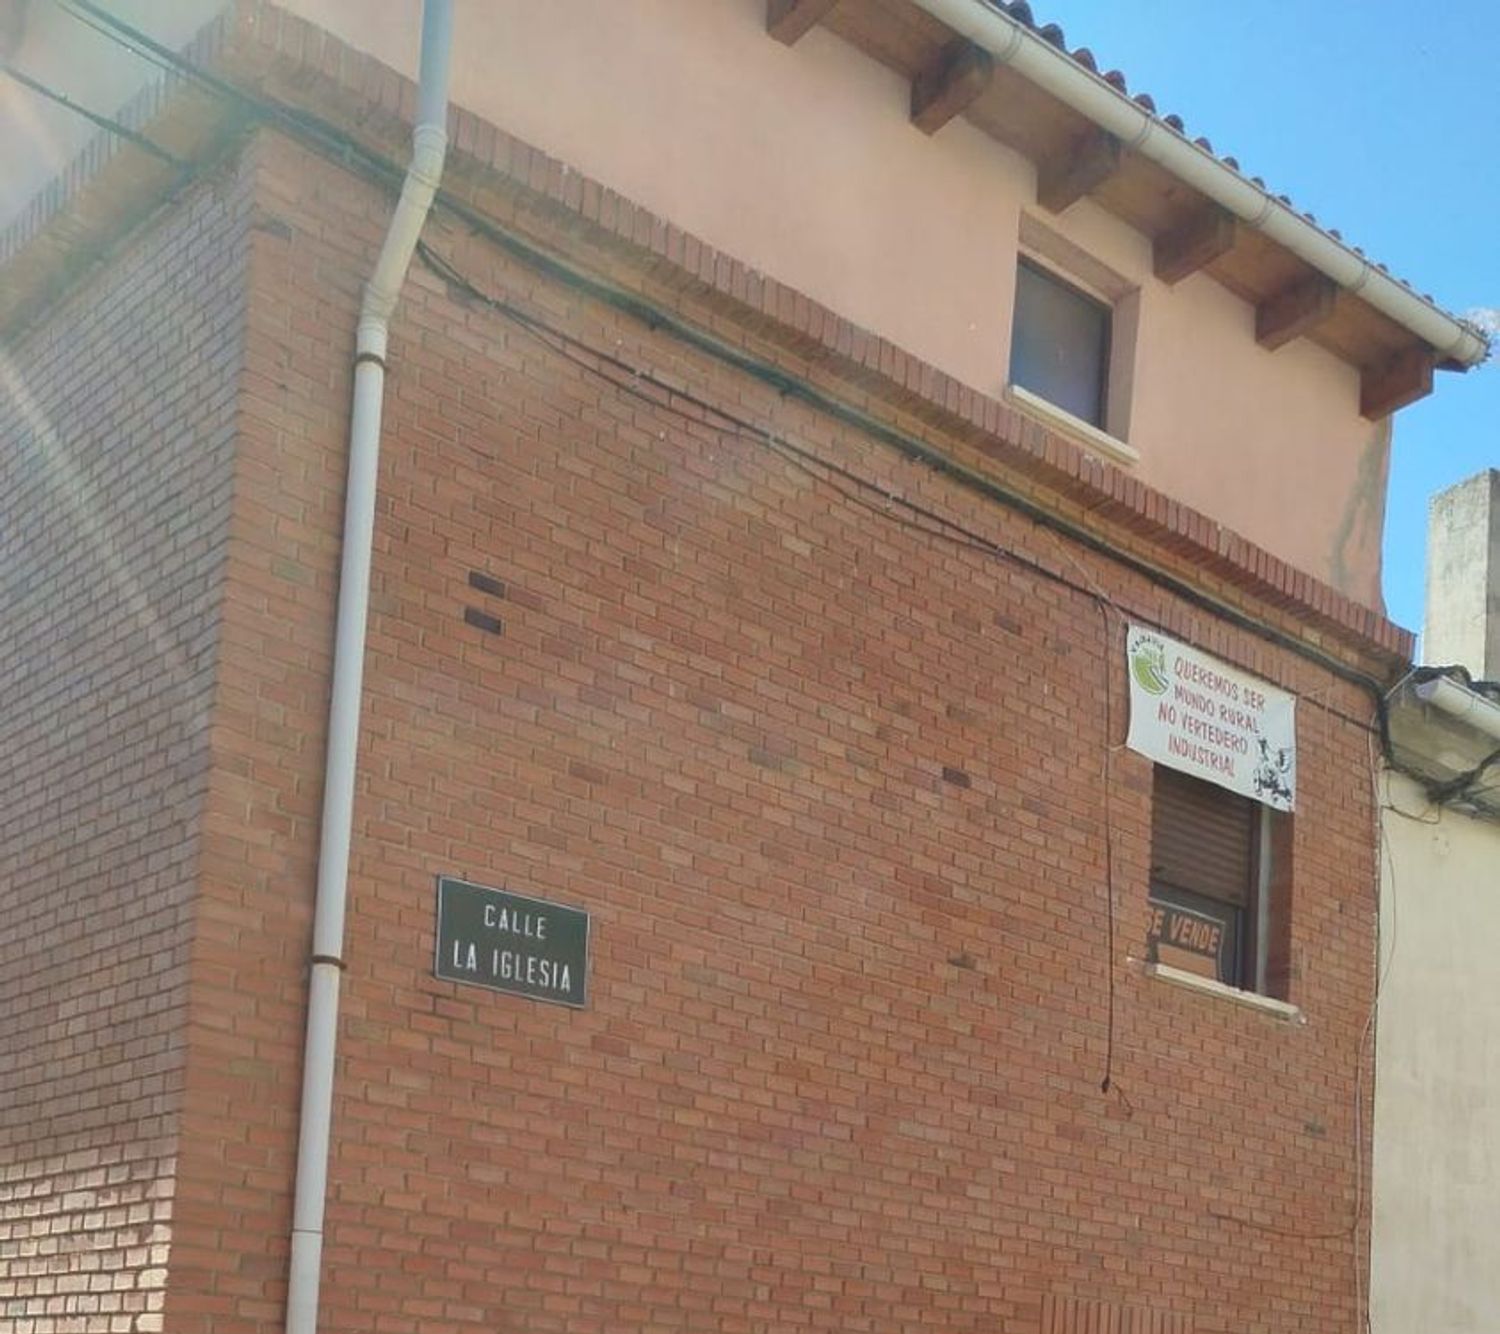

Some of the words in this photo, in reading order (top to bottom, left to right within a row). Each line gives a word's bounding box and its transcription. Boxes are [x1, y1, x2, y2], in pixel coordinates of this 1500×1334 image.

[1174, 656, 1239, 701] QUEREMOS
[1244, 687, 1266, 713] SER
[1174, 684, 1215, 716] MUNDO
[1219, 706, 1260, 734] RURAL
[1158, 702, 1177, 725] NO
[1181, 712, 1248, 755] VERTEDERO
[1168, 735, 1235, 777] INDUSTRIAL
[484, 904, 547, 939] CALLE
[1170, 913, 1220, 952] VENDE
[453, 939, 477, 972] LA
[493, 949, 571, 992] IGLESIA
